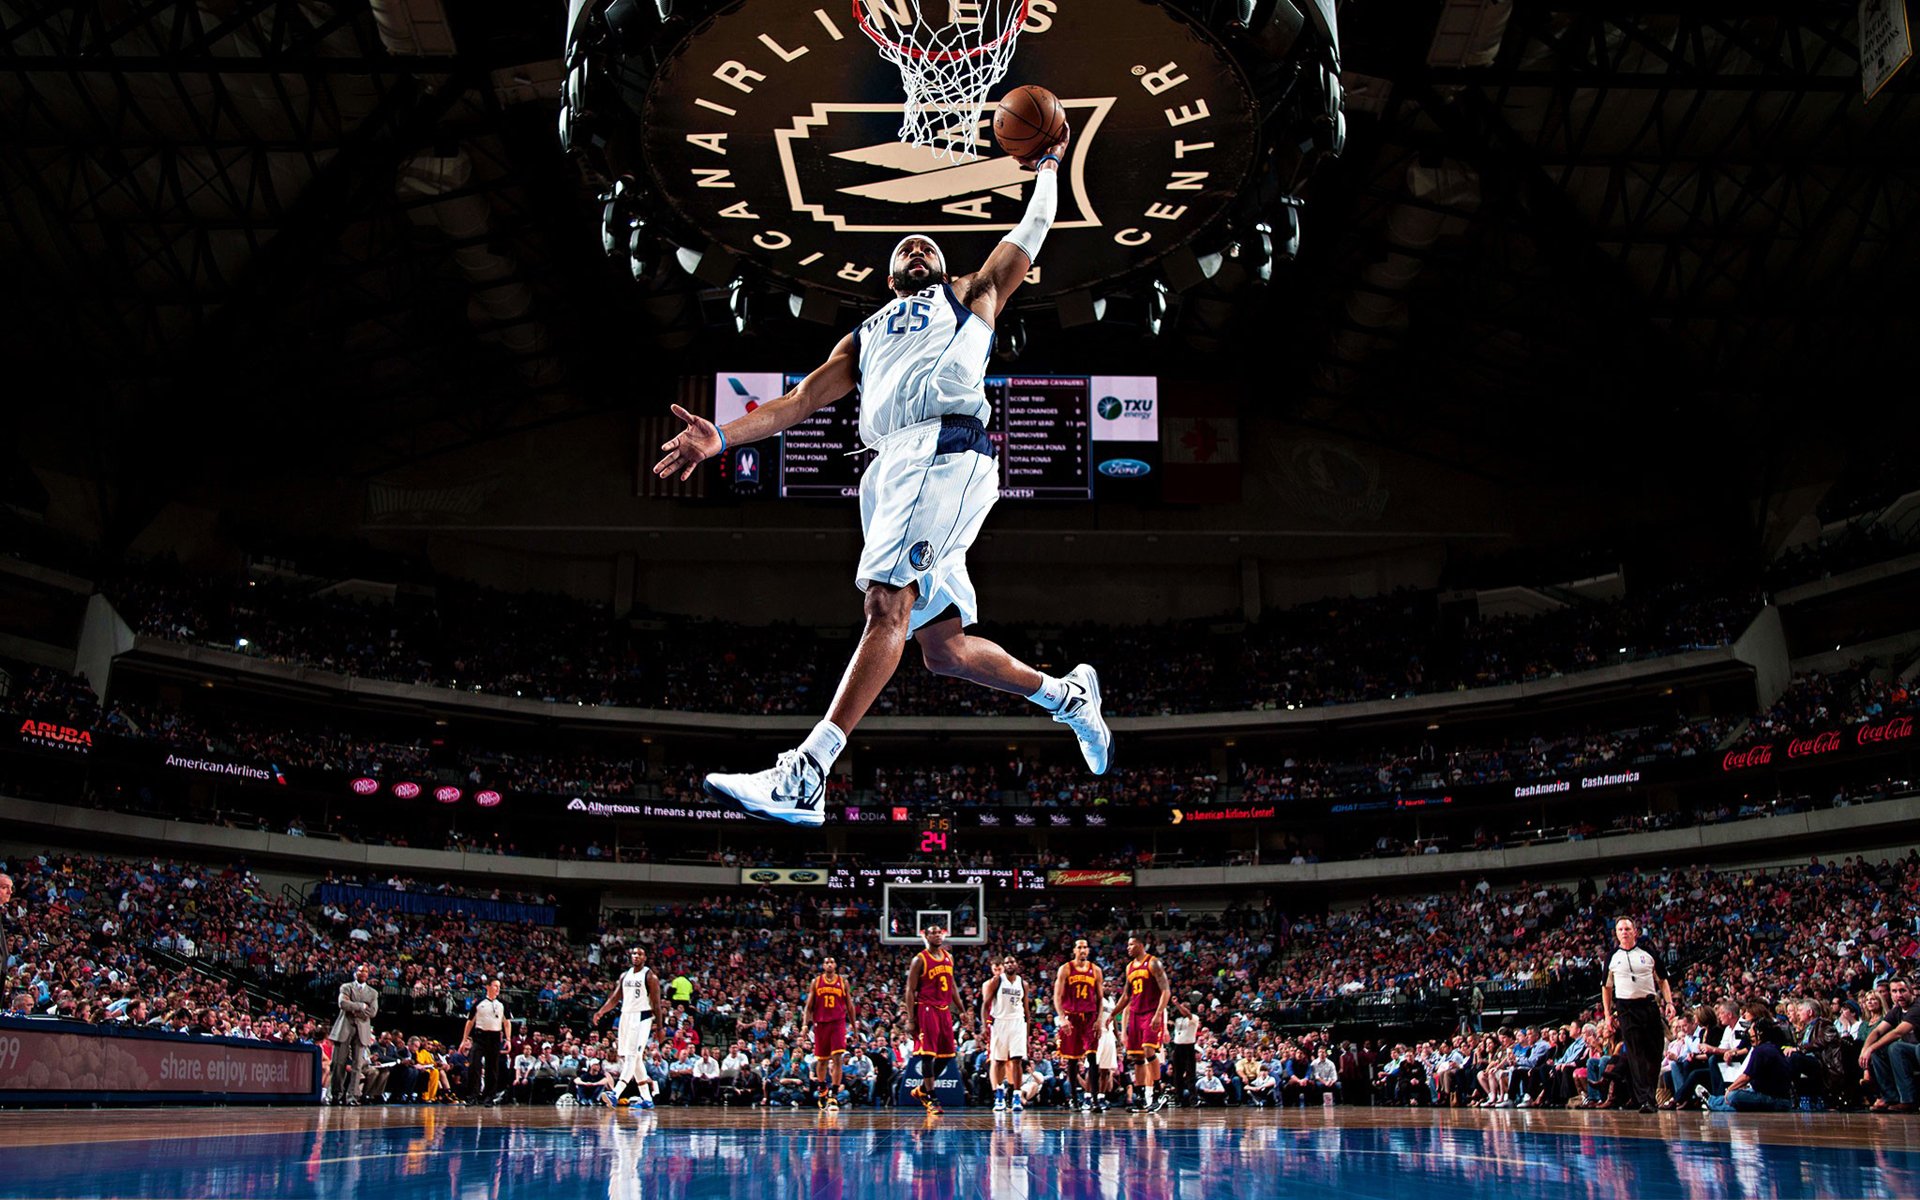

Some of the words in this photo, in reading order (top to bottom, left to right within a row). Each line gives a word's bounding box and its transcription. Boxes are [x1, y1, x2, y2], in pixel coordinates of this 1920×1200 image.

[1114, 61, 1214, 246] CENTER
[887, 301, 931, 335] 25
[1124, 400, 1153, 411] TXU
[1124, 411, 1151, 419] energy
[1108, 461, 1140, 475] Ford
[20, 719, 92, 746] ARUBA
[22, 736, 88, 754] networks
[166, 754, 224, 773] American
[225, 763, 270, 779] Airlines
[588, 802, 641, 813] Albertsons
[654, 807, 686, 816] means
[697, 809, 721, 820] great
[1195, 810, 1225, 820] American
[1225, 808, 1250, 819] Airlines
[921, 831, 947, 852] 24
[868, 878, 875, 886] 5
[999, 878, 1007, 887] 2
[1055, 871, 1114, 885] Budweiser
[940, 976, 948, 991] 3
[1133, 979, 1142, 994] 33
[635, 989, 641, 998] 9
[1076, 984, 1088, 999] 14
[824, 995, 835, 1008] 13
[161, 1052, 204, 1080] share.
[207, 1055, 248, 1087] enjoy.
[251, 1061, 290, 1084] repeat.
[905, 1078, 958, 1089] SOUWEST
